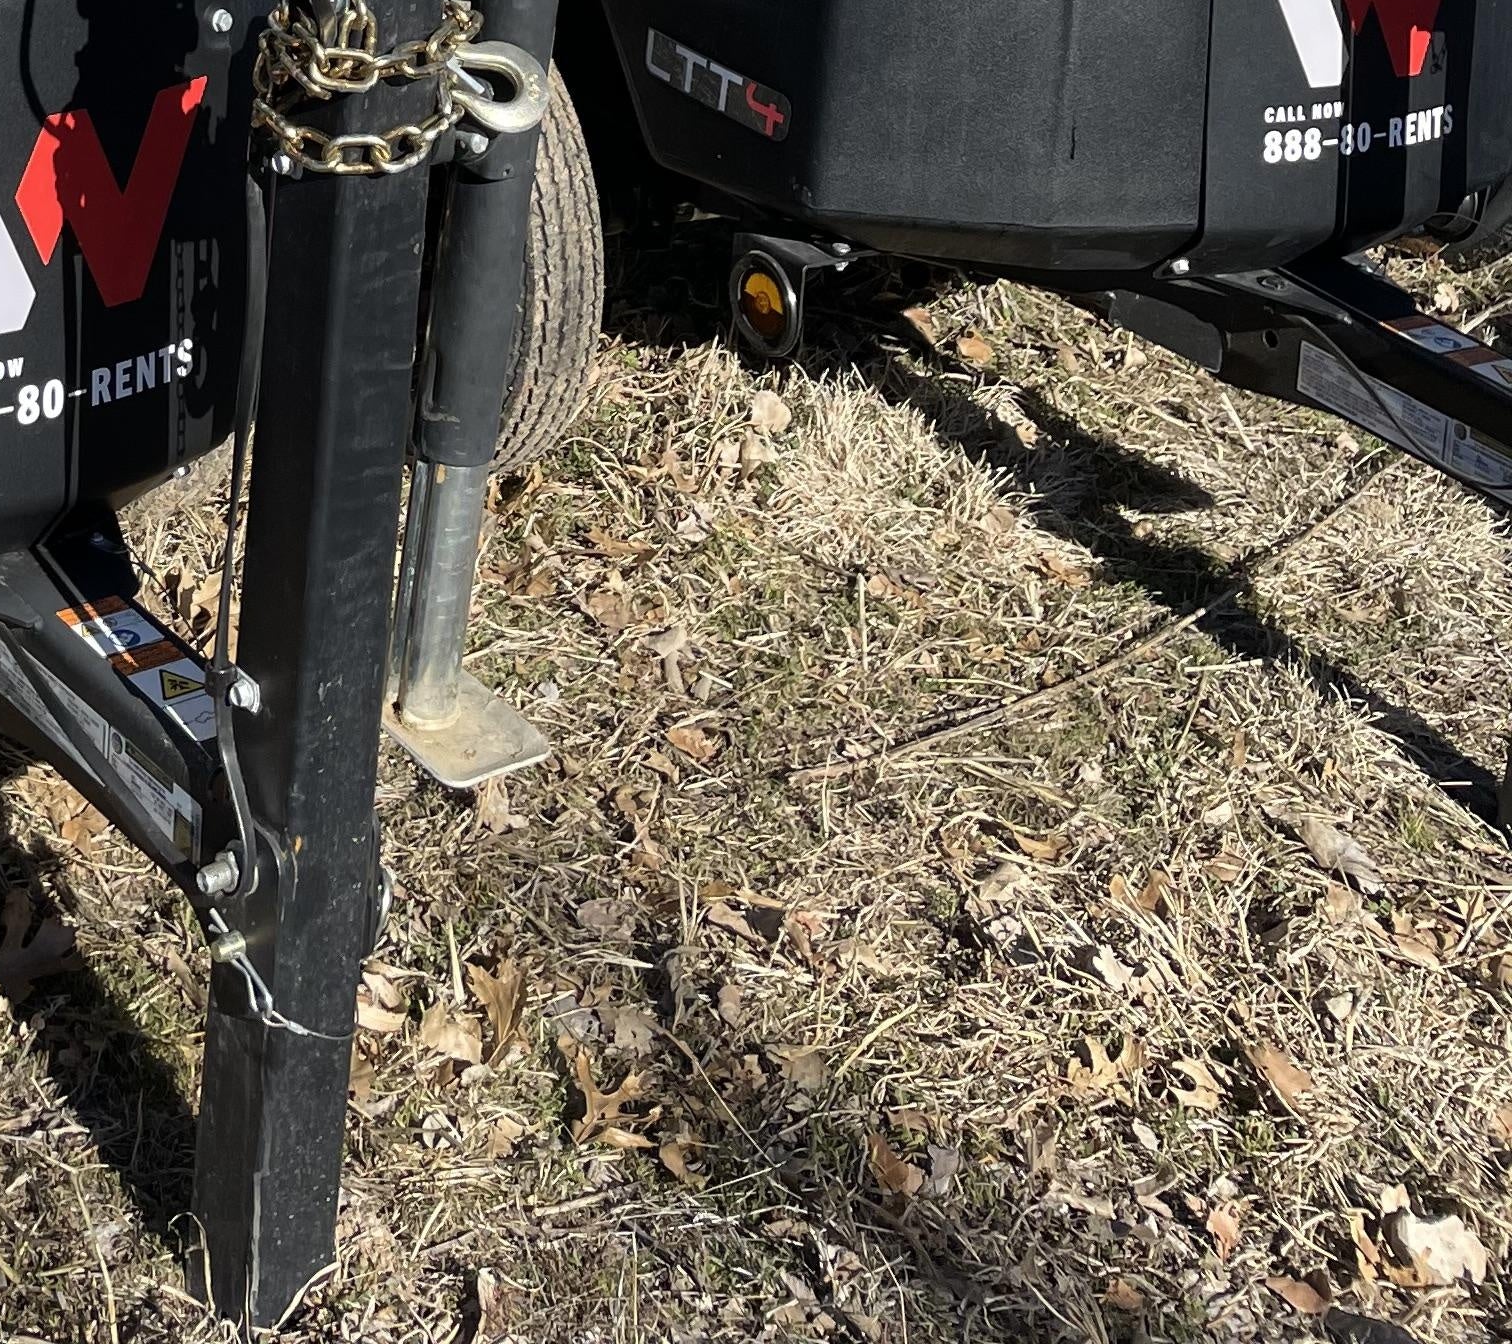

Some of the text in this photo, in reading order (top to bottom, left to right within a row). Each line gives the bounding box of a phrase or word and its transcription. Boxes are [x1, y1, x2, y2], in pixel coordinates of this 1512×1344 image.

[645, 27, 785, 137] LTT4
[1263, 104, 1453, 163] 888-80-RENTS
[1264, 101, 1344, 124] CALL NOW
